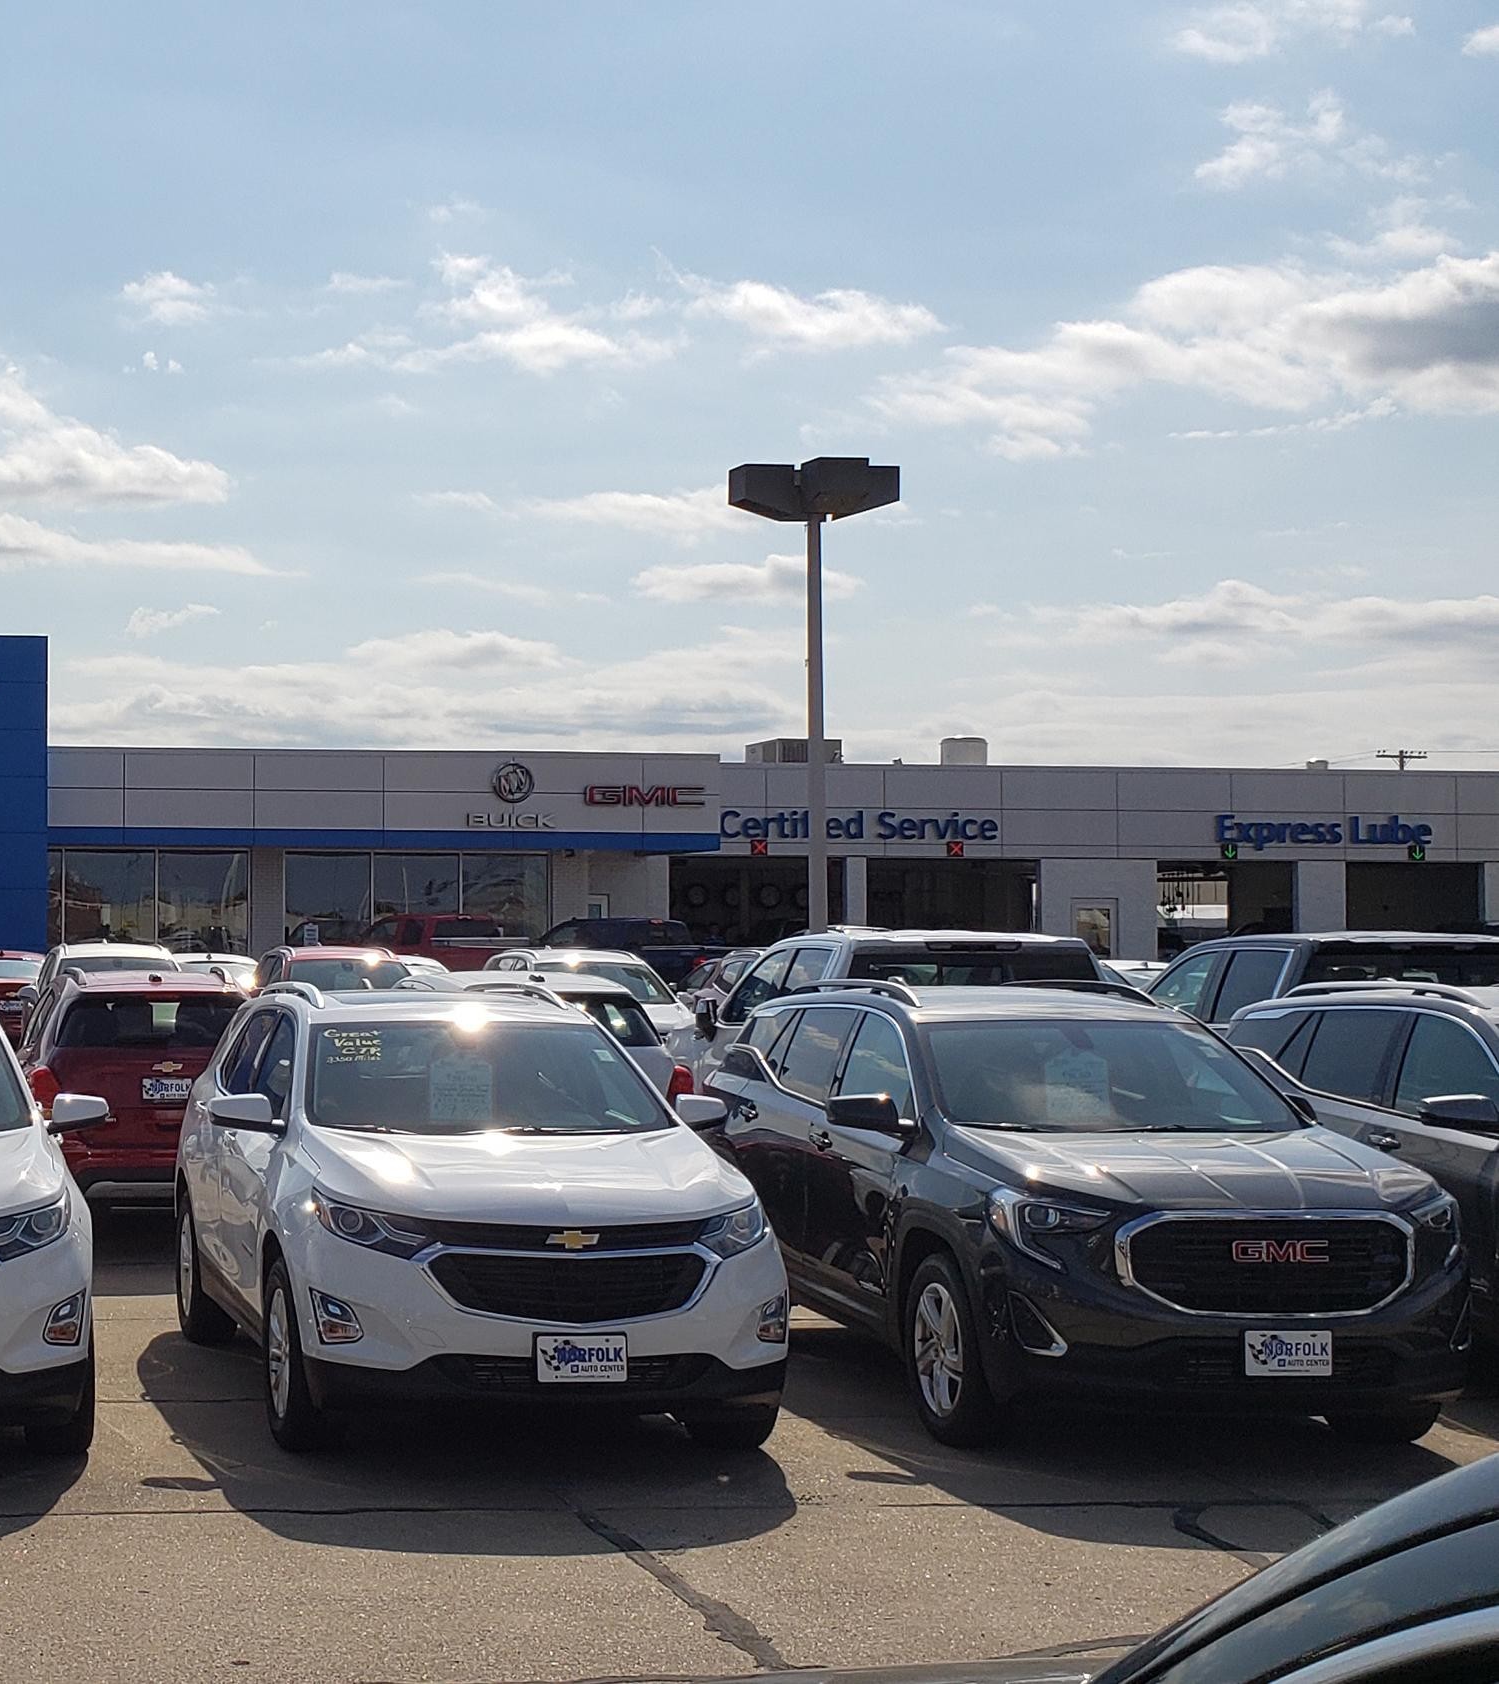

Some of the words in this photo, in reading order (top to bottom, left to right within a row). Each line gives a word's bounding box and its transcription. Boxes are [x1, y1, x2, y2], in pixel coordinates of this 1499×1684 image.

[584, 785, 705, 807] GMC
[467, 812, 557, 829] BUICK
[719, 810, 864, 839] Certifed
[876, 811, 999, 841] Service
[1214, 814, 1343, 851] Express
[1349, 815, 1433, 845] Lube
[323, 1028, 382, 1038] Great
[333, 1038, 382, 1047] Value
[1232, 1240, 1330, 1263] GMC
[557, 1347, 624, 1363] NORFOLK
[1262, 1342, 1330, 1357] NORFOLK
[581, 1364, 598, 1373] AUTO
[599, 1364, 625, 1373] CENTER
[1287, 1359, 1304, 1367] AUTO
[1306, 1359, 1330, 1367] CENTER
